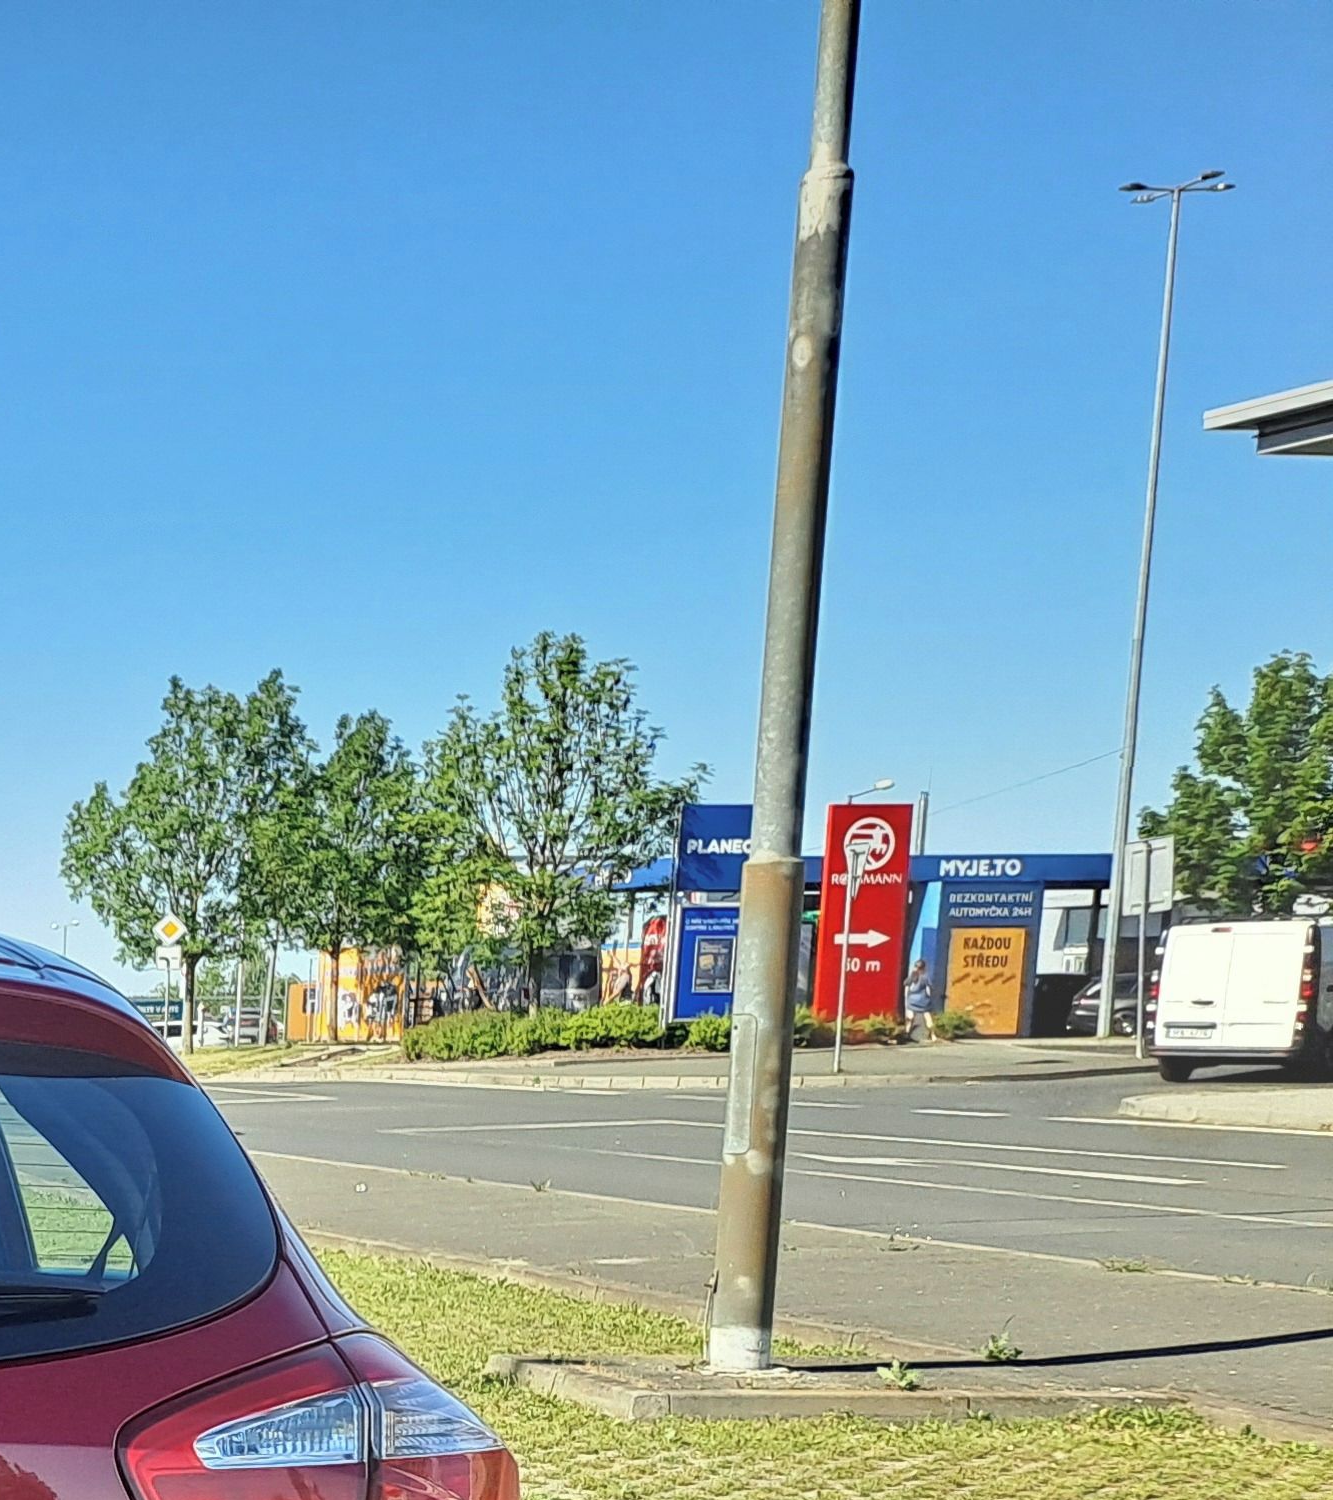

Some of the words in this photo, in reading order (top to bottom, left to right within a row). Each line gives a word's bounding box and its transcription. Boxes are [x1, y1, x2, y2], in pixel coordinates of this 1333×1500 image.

[939, 859, 1022, 877] MYJE.TO
[831, 873, 903, 885] ROMANN
[949, 891, 1034, 904] BEZKONTAKTNÍ
[949, 905, 1009, 917] AUTOMYČKA
[1012, 906, 1033, 917] 24H
[963, 935, 1012, 950] KAŽDOU
[865, 960, 881, 972] m
[963, 953, 1009, 969] STŘEDU
